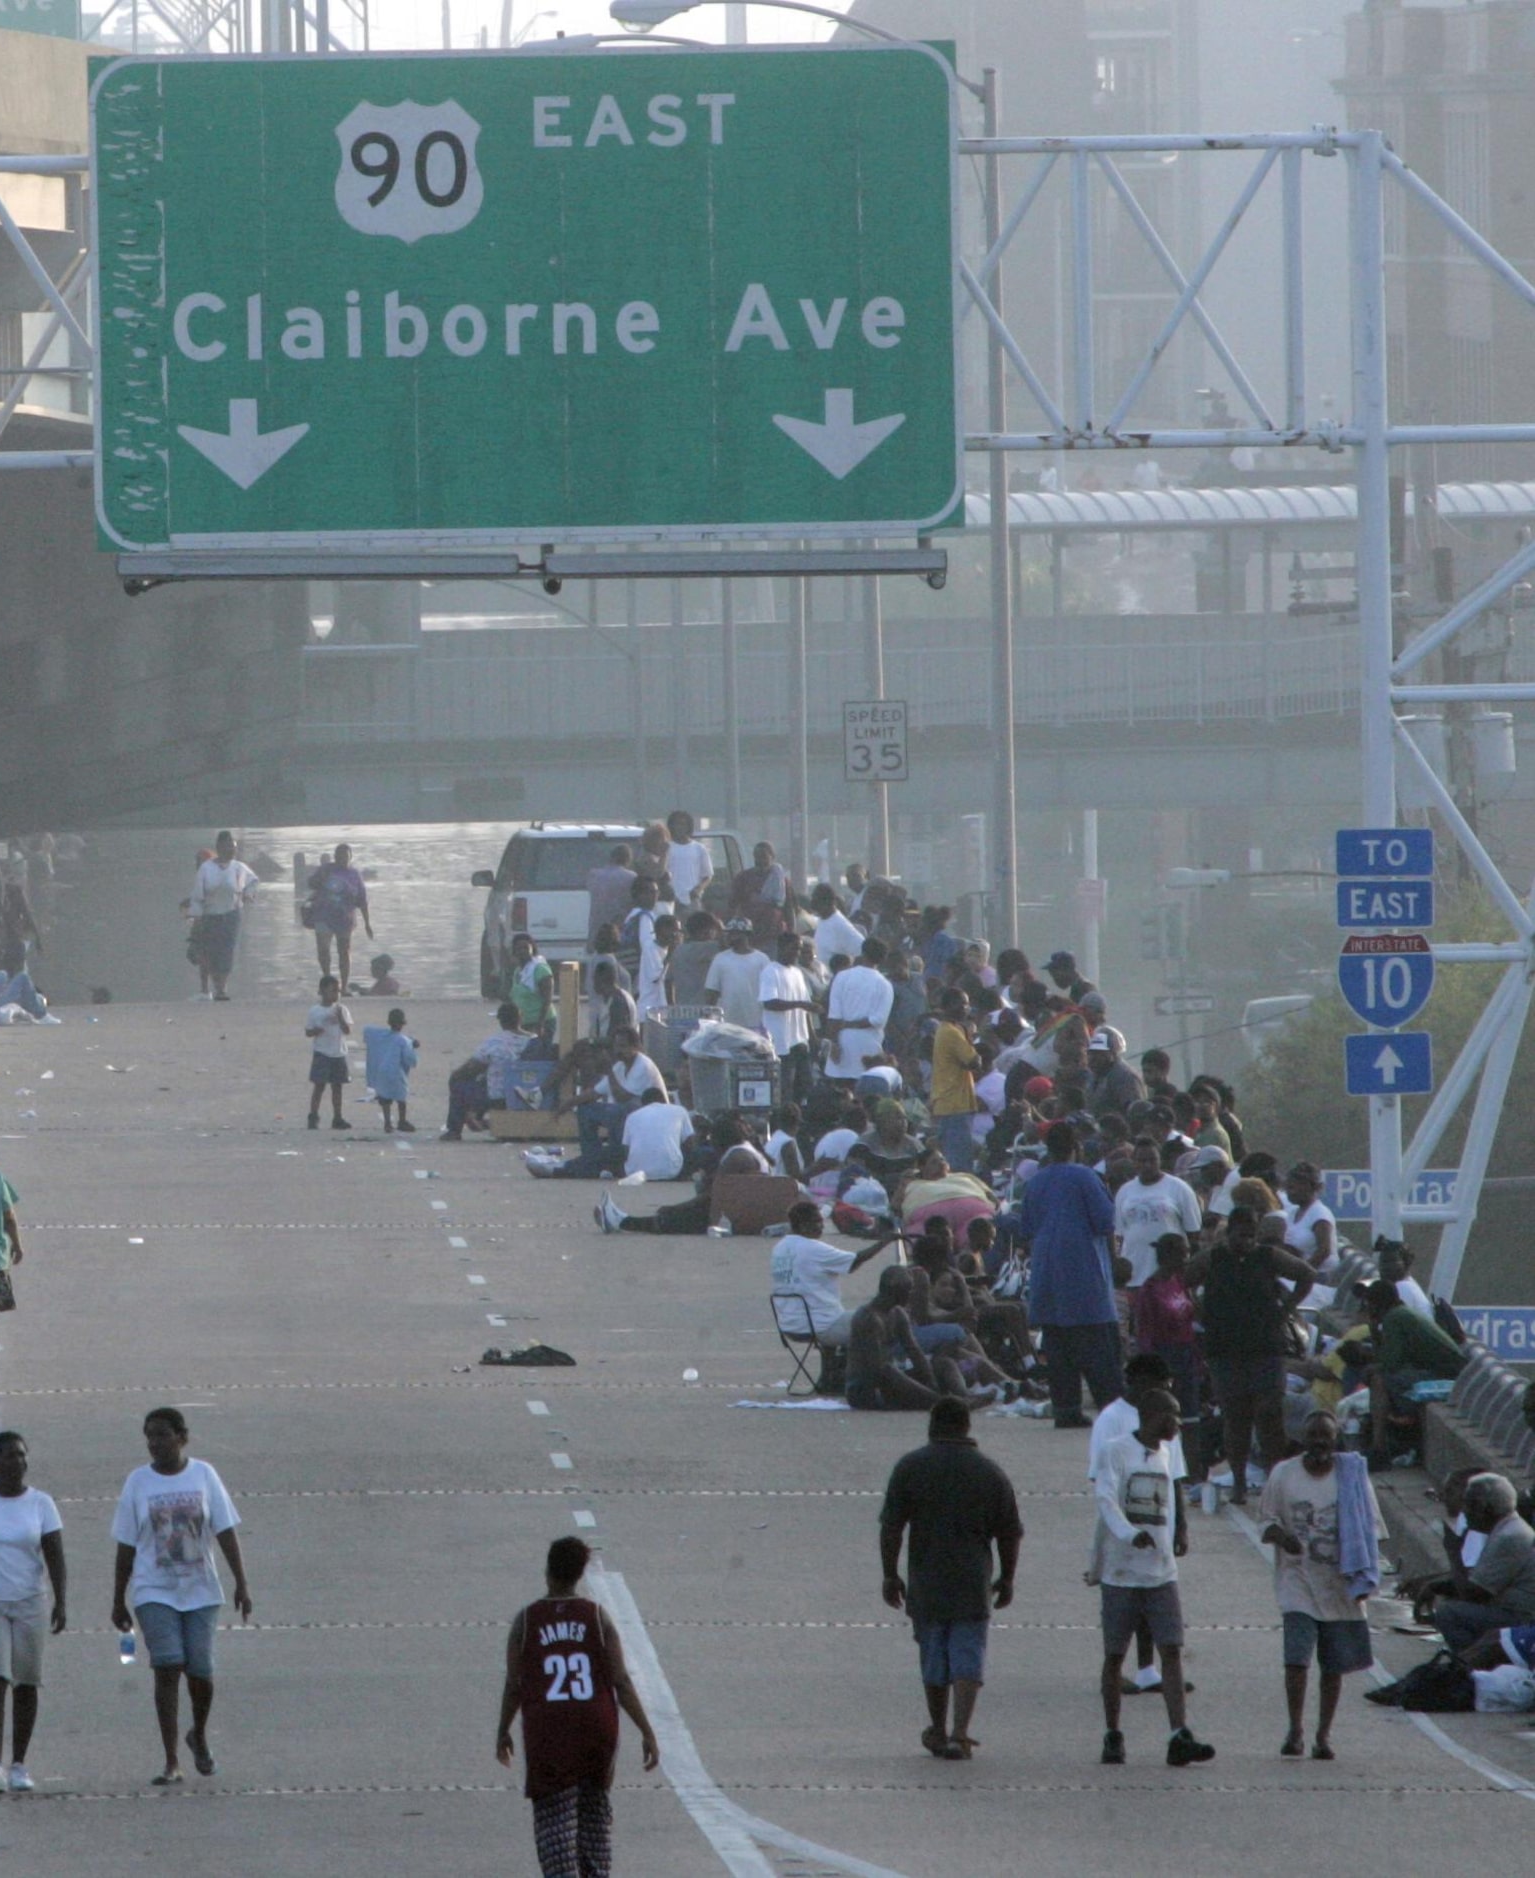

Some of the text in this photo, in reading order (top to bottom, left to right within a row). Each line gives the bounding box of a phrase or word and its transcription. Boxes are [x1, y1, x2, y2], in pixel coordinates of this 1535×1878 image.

[533, 93, 736, 149] EAST
[350, 129, 467, 209] 90
[173, 283, 906, 362] Claiborne Ave
[848, 706, 902, 722] SPEED
[854, 726, 896, 739] LIMIT
[852, 744, 903, 772] 35
[1361, 839, 1408, 867] TO
[1350, 889, 1418, 919] EAST
[1351, 938, 1421, 952] INTERSTATE
[1363, 957, 1413, 1011] 10
[538, 1621, 586, 1646] JAMES
[544, 1652, 594, 1701] 23
